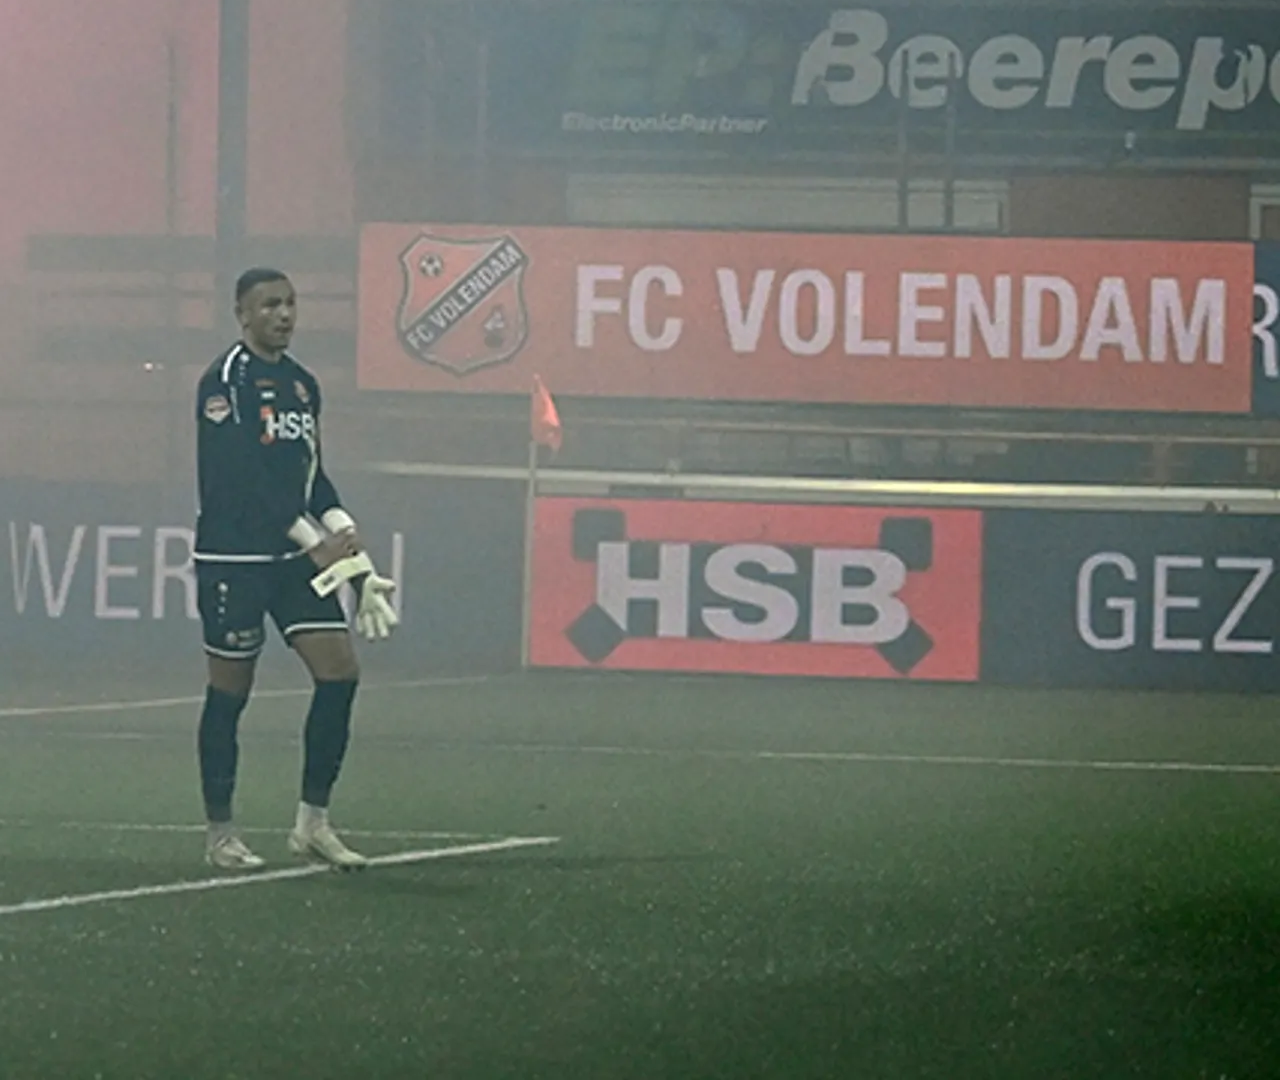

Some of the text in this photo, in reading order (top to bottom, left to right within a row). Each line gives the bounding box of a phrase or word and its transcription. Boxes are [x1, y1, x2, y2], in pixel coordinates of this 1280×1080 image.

[791, 7, 1280, 131] Beerep
[561, 111, 768, 134] ElectronicPartner
[406, 243, 523, 350] FC VOLENDAM
[575, 264, 1227, 365] FC VOLENDAM
[596, 541, 912, 645] HSB
[1077, 552, 1274, 653] GEZ
